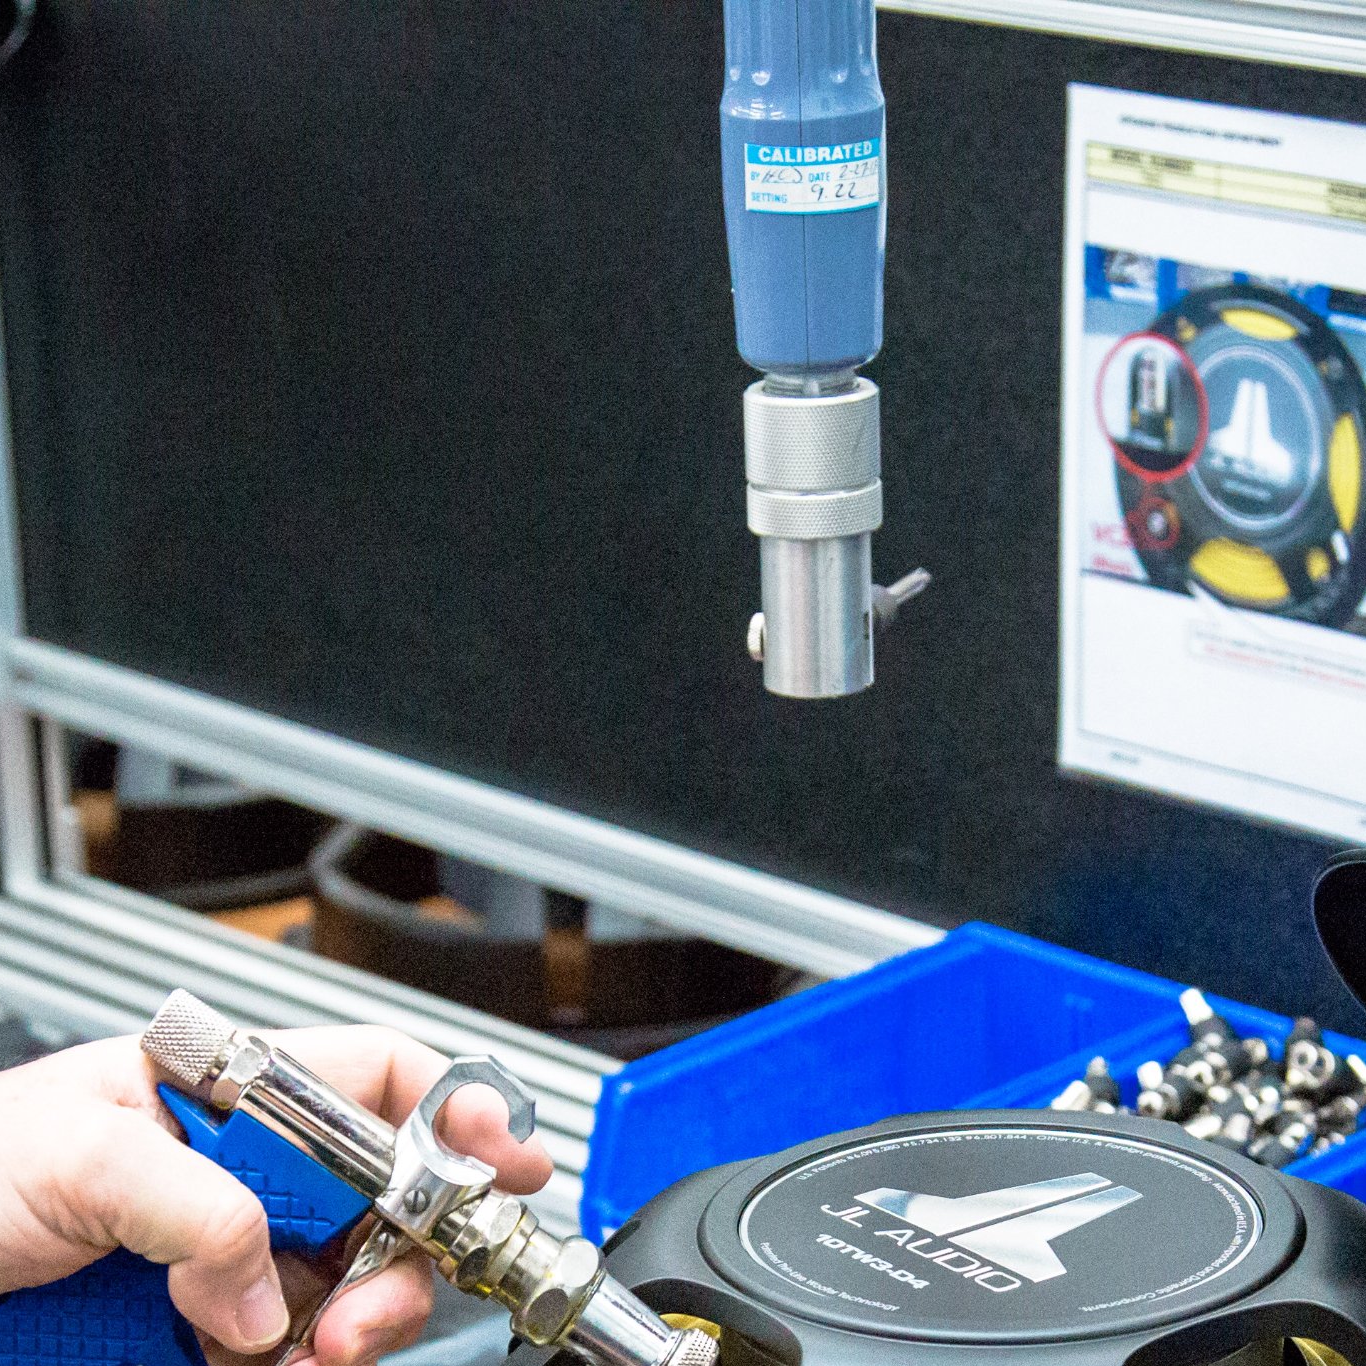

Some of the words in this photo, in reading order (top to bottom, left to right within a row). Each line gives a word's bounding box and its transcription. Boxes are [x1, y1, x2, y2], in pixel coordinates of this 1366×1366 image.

[758, 141, 873, 163] CALIBRATED
[808, 170, 831, 182] DATE
[1037, 1135, 1069, 1143] Other
[1105, 1142, 1144, 1155] Foreign
[821, 1204, 870, 1228] JL
[874, 1229, 1022, 1293] AUDIO
[816, 1233, 930, 1290] 10TW3-D4
[837, 1291, 900, 1311] Technology
